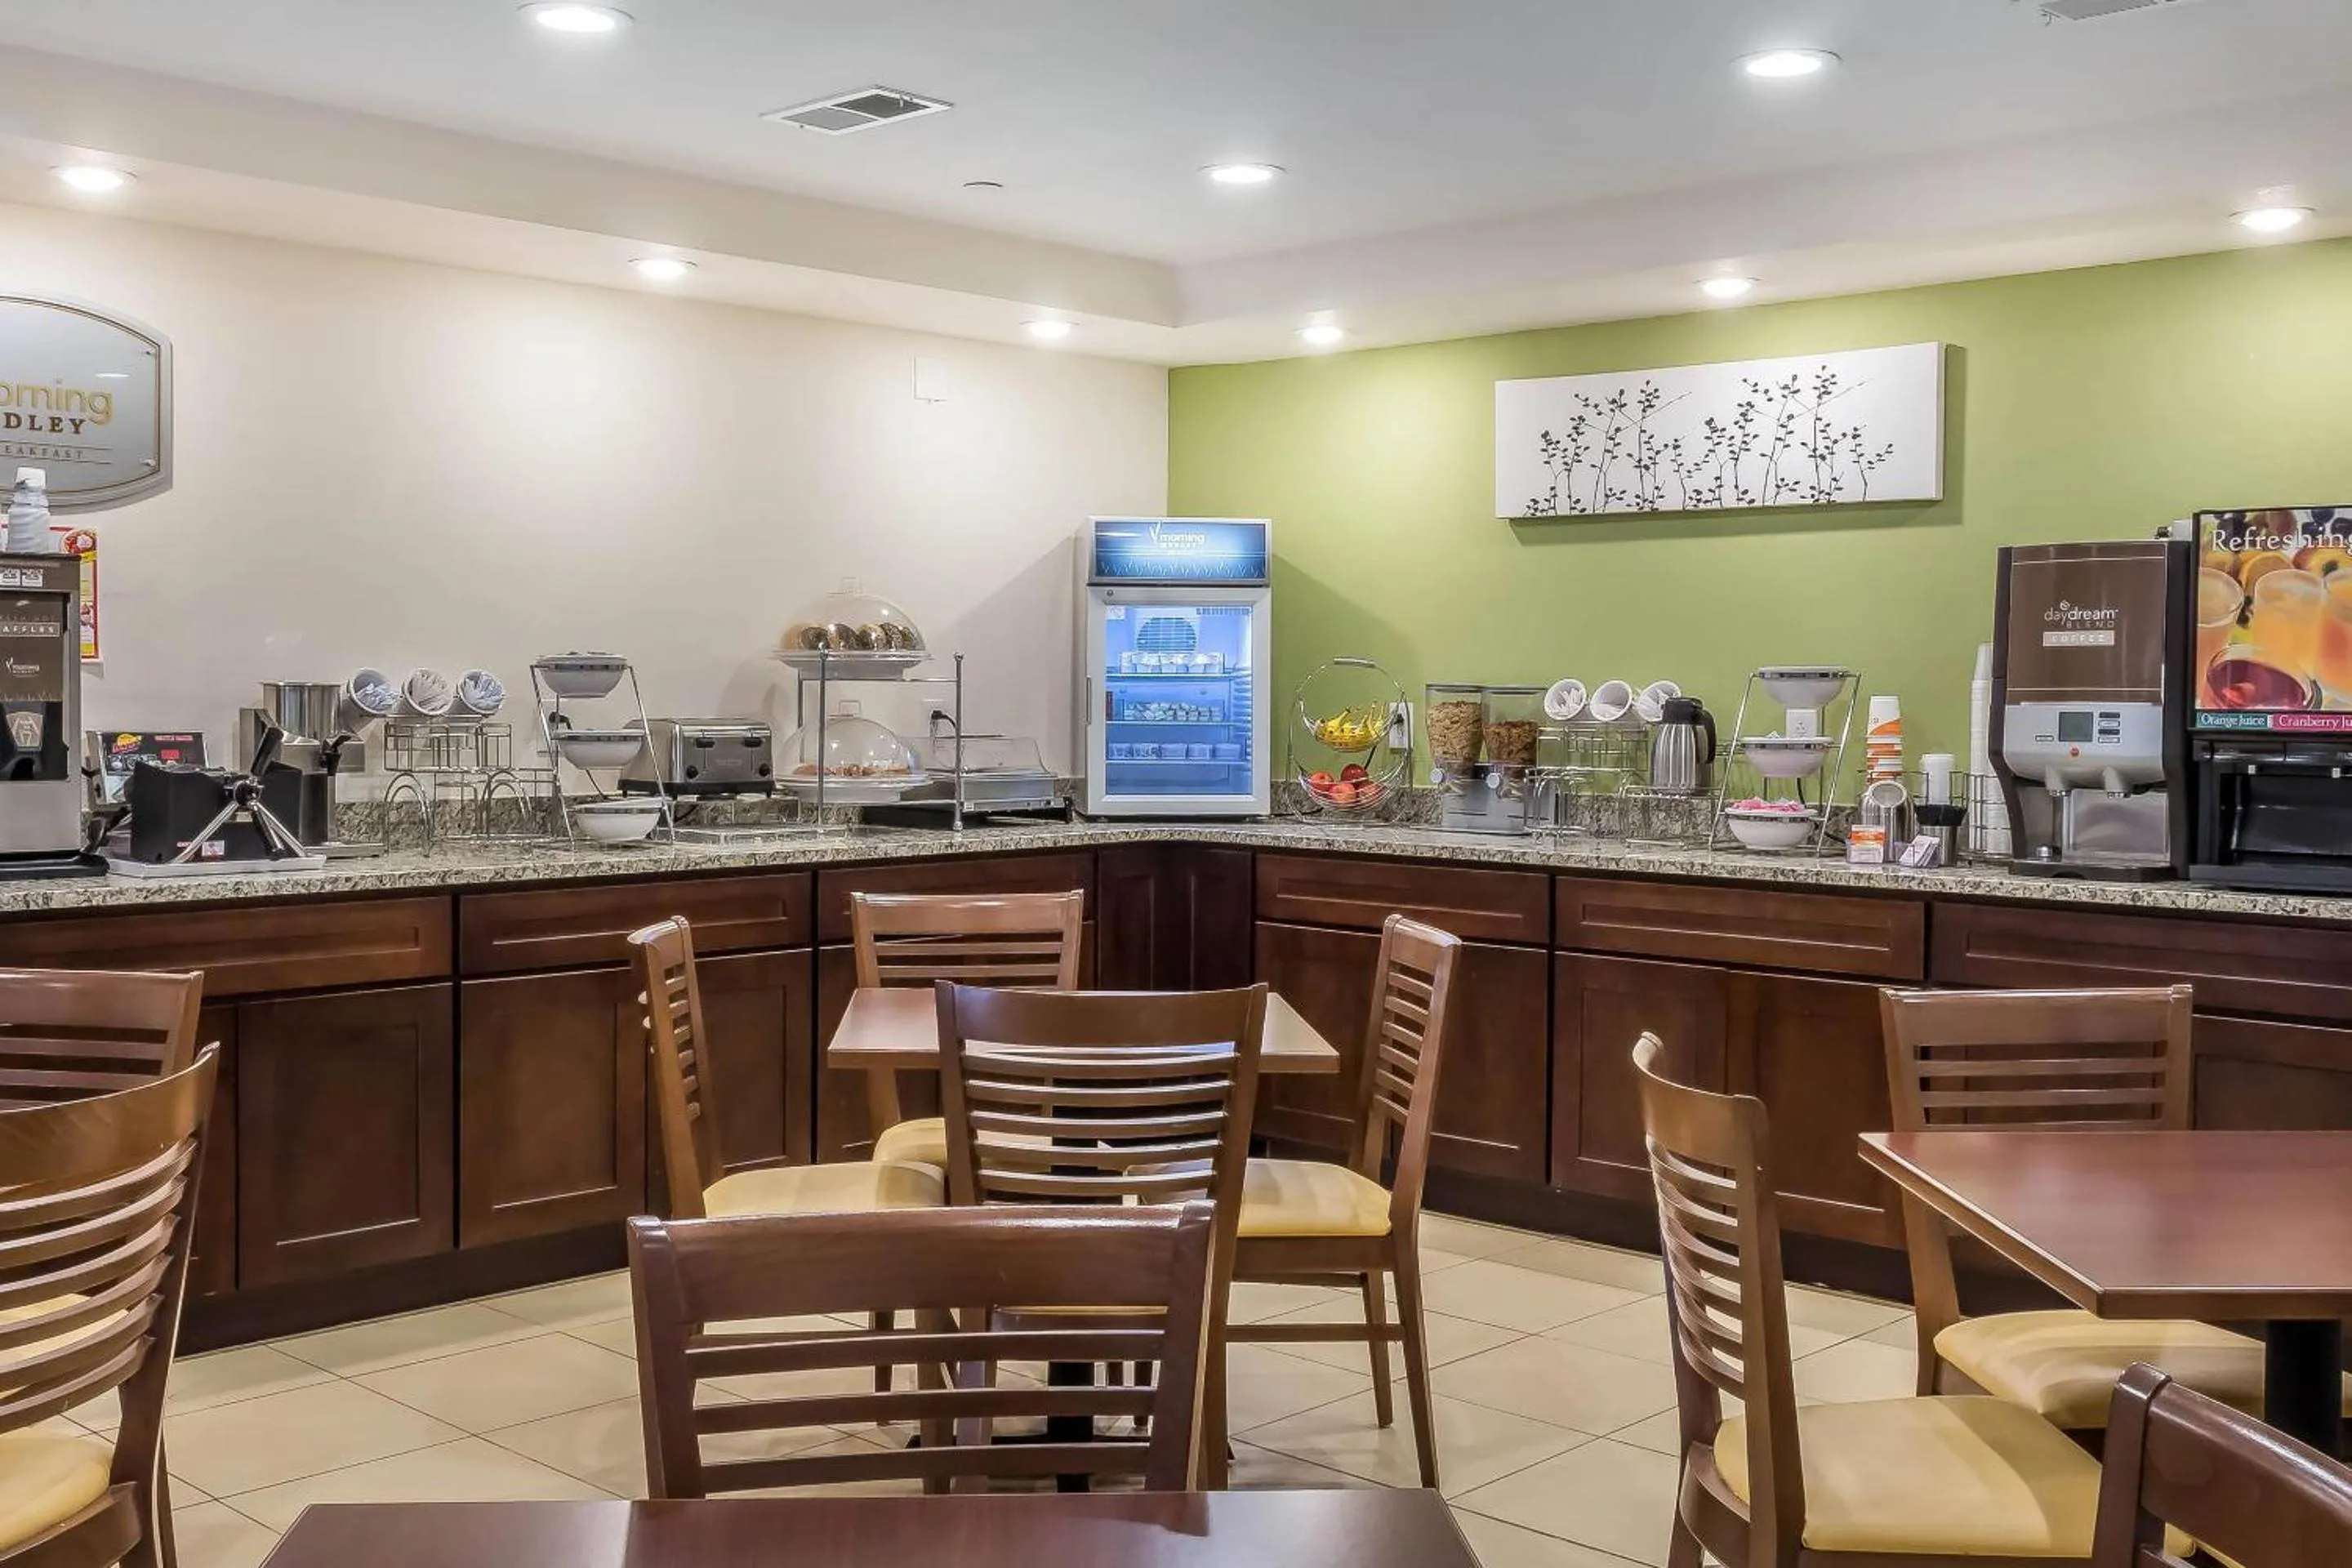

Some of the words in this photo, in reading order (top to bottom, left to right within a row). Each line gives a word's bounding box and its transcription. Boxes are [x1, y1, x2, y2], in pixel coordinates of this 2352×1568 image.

[3, 412, 86, 434] DLEY
[2044, 606, 2115, 626] daydream
[2065, 621, 2114, 629] BLEND
[2201, 713, 2238, 728] Orange
[2238, 714, 2265, 726] Juice
[2278, 715, 2339, 728] Cranberry
